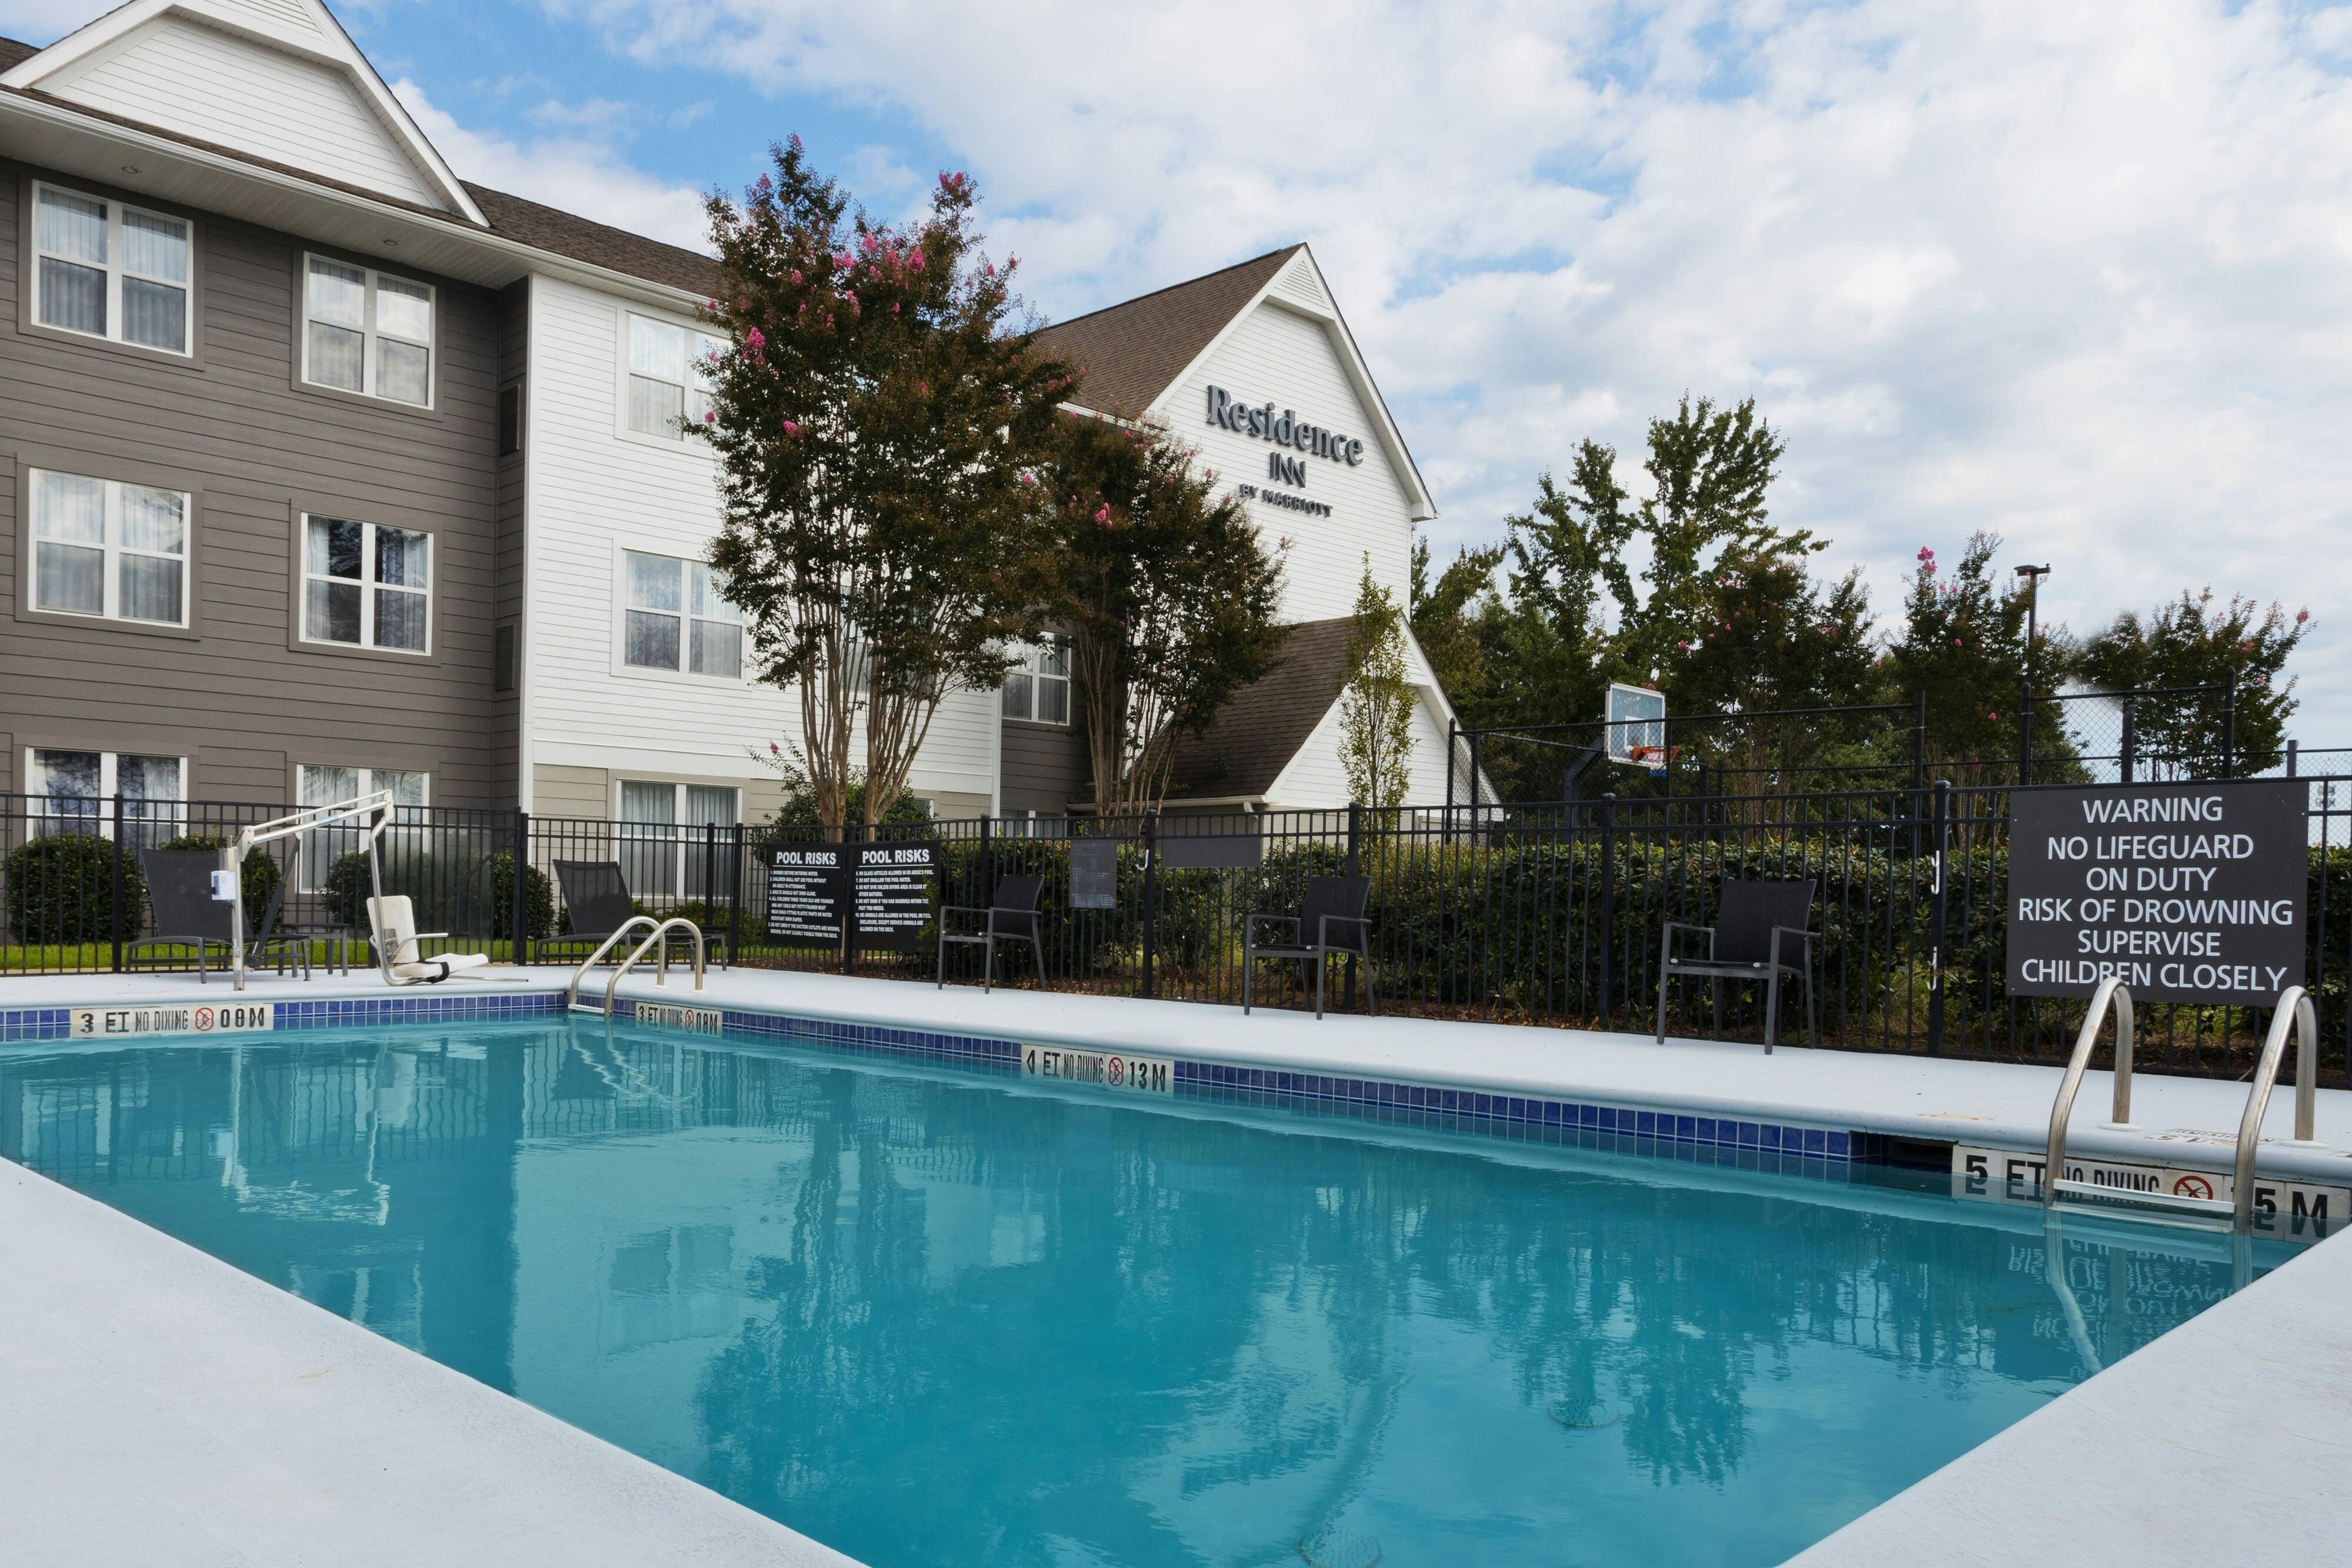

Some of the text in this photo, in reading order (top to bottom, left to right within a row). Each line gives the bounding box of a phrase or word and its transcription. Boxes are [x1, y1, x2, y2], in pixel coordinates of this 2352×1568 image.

[1206, 385, 1364, 466] Residence
[1269, 452, 1306, 488] INN
[1240, 483, 1333, 518] BY MARRIOTT
[2083, 796, 2223, 823] WARNING
[776, 851, 836, 865] POOL RISKS
[862, 849, 930, 864] POOL RISKS
[2048, 834, 2254, 860] NO LIFEGUARD
[2086, 867, 2217, 892] ON DUTY
[2019, 898, 2293, 925] RISK OF DROWNING
[2078, 930, 2221, 957] SUPERVISE
[2022, 958, 2287, 991] CHILDREN CLOSELY
[1966, 1154, 1987, 1180] 5
